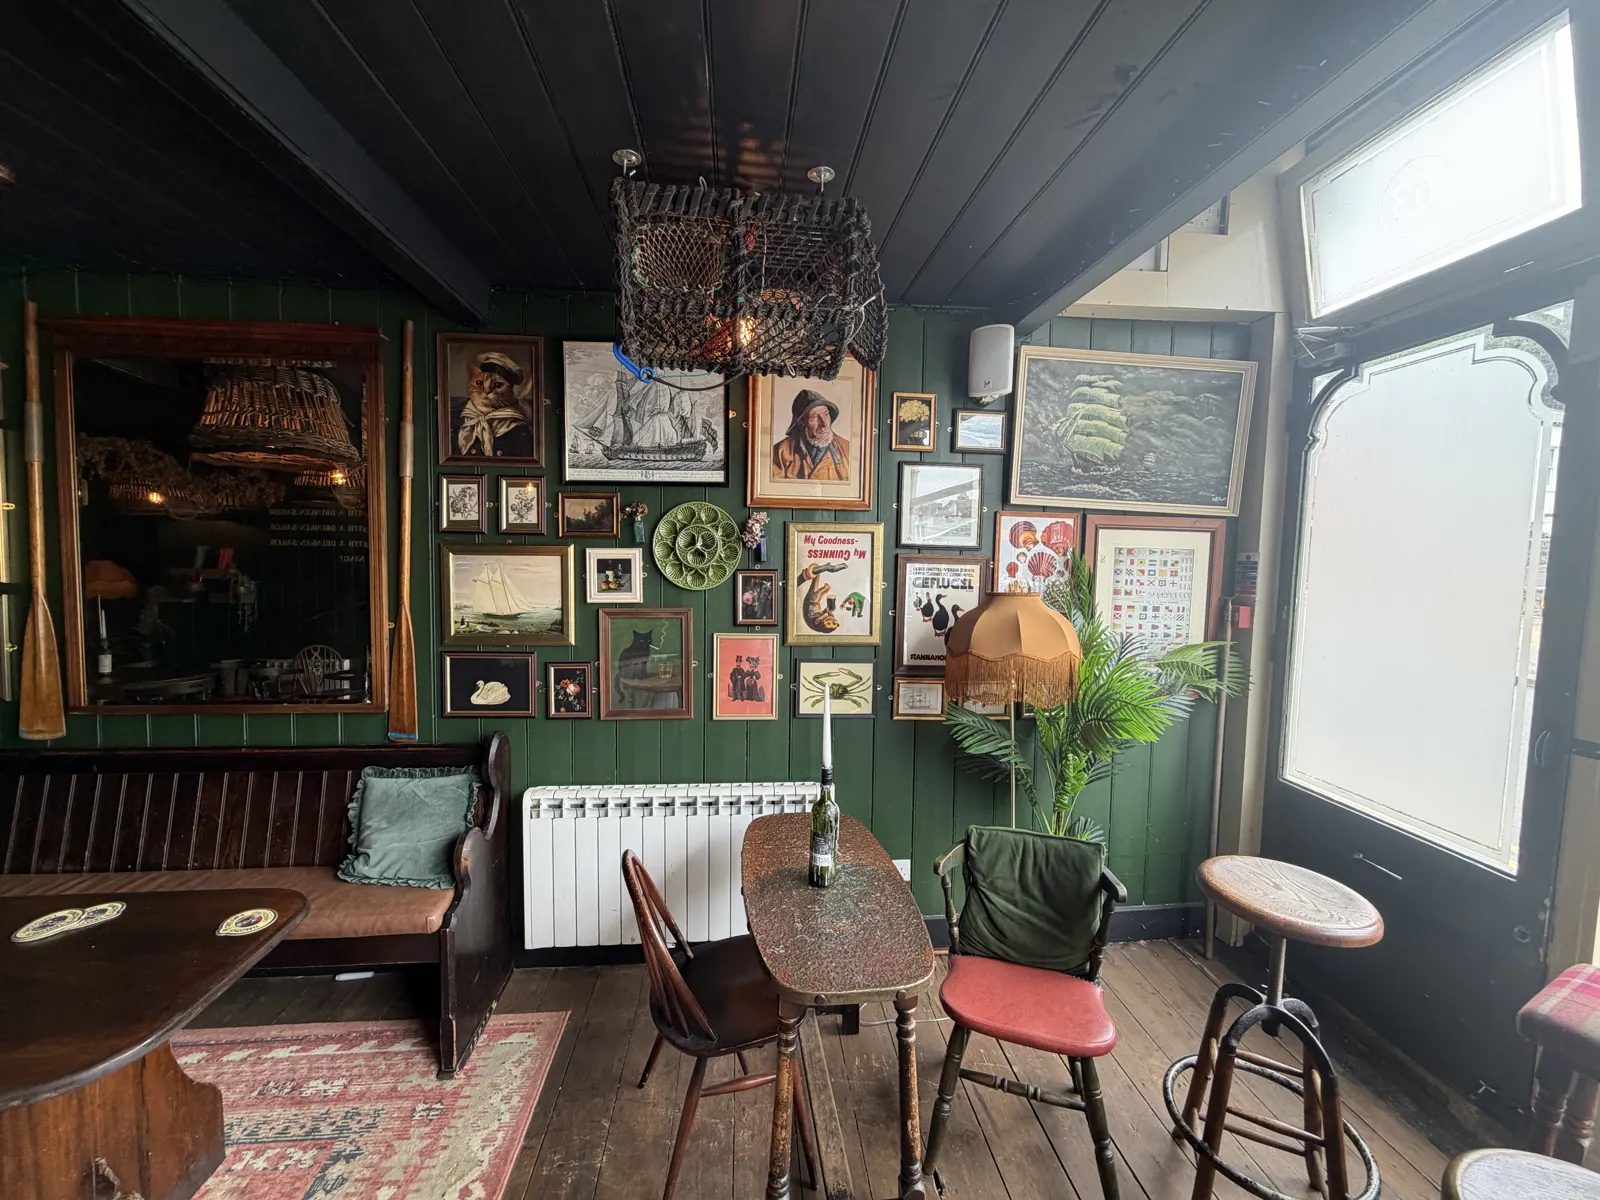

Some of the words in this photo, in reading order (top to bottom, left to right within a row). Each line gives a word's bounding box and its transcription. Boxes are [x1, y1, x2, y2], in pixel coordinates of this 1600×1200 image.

[804, 535, 816, 546] My
[807, 549, 851, 561] GUINNESS
[854, 548, 867, 559] My
